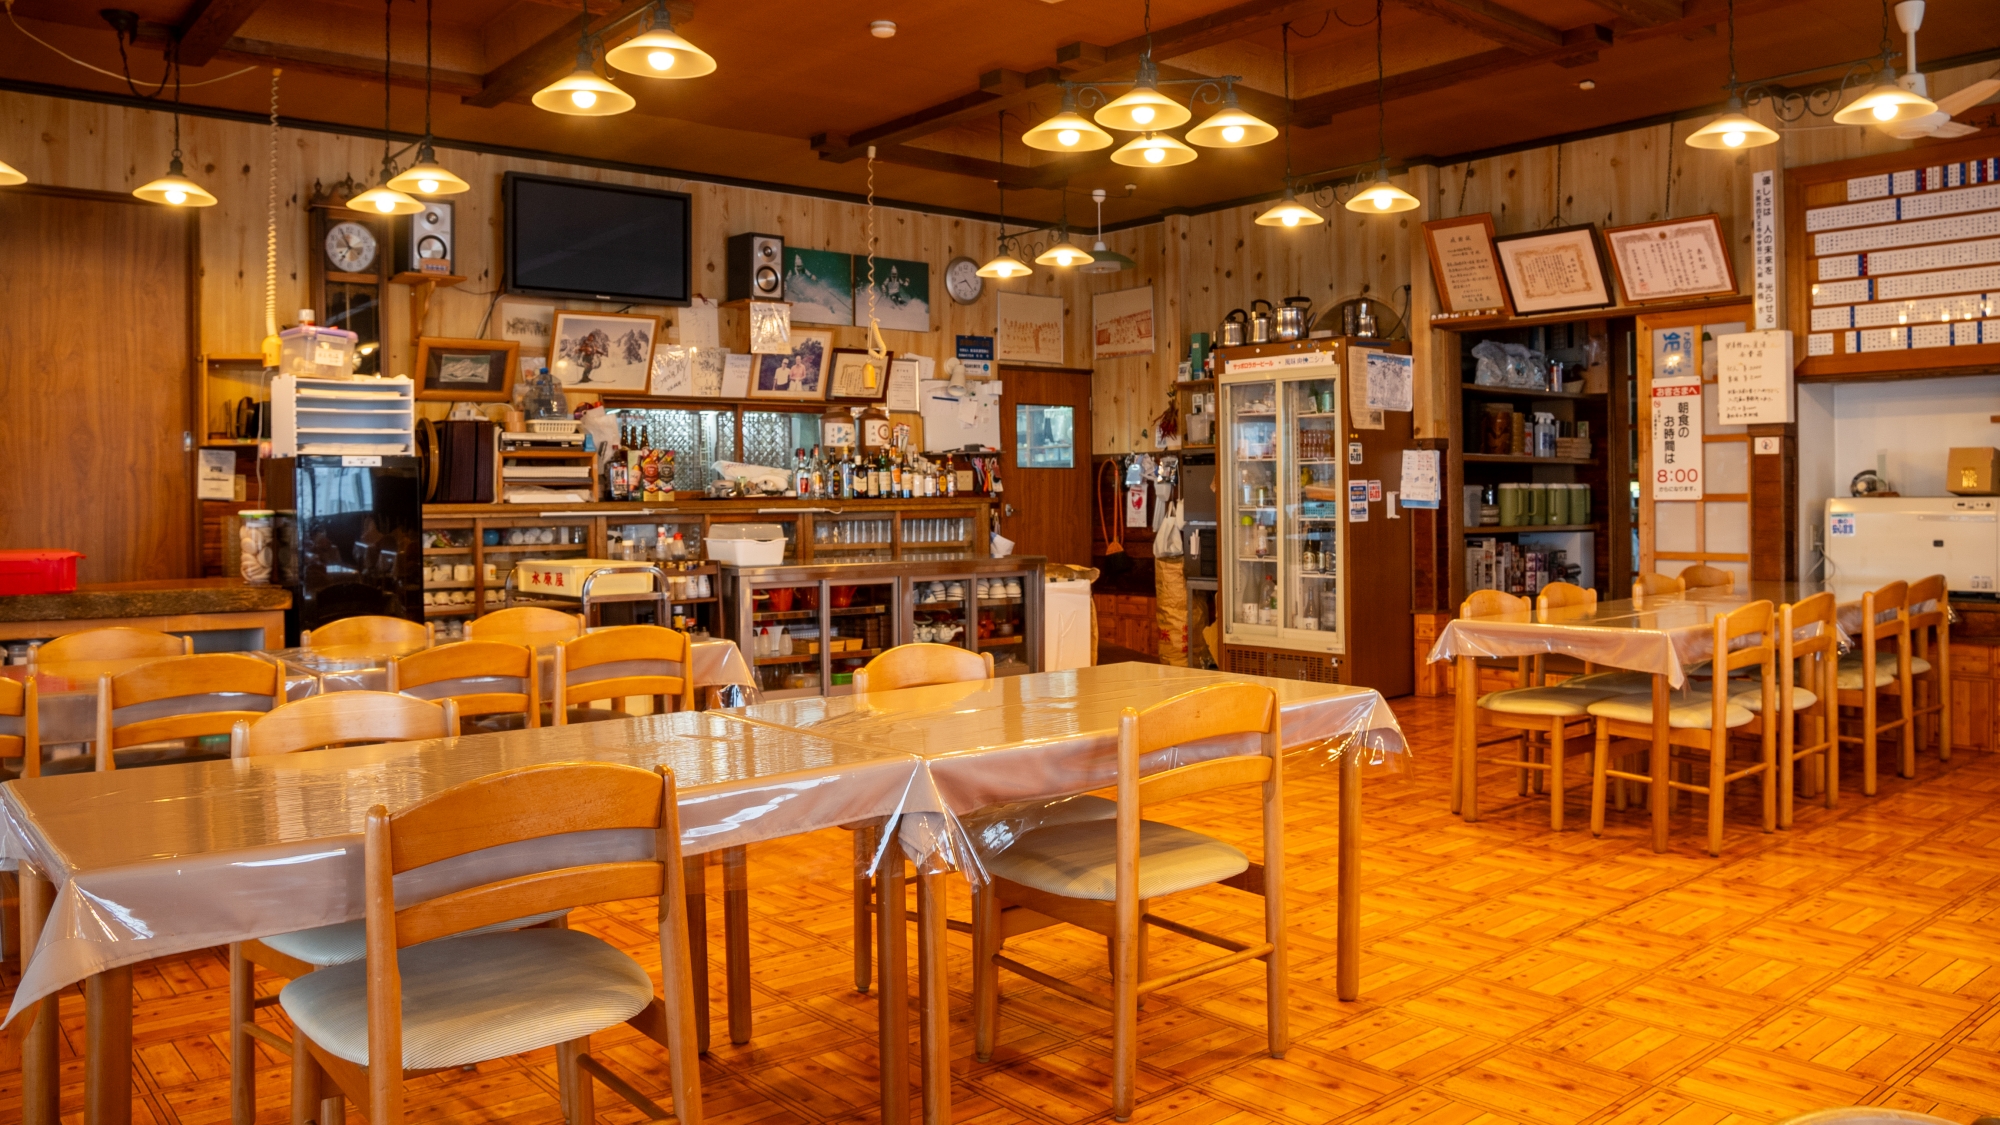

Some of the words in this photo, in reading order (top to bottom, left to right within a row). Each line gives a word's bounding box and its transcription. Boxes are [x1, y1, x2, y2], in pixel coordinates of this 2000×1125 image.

[1762, 176, 1772, 216] 優しさは
[1763, 224, 1773, 275] 人の未来を
[1764, 284, 1774, 324] 光らせる
[1233, 360, 1274, 370] サッポロラガービール
[1655, 387, 1698, 396] お客さまへ
[1677, 401, 1690, 439] 朝食の
[1663, 415, 1676, 465] お時間は
[1657, 468, 1698, 484] 8:00
[1658, 485, 1697, 493] からになります。
[531, 571, 564, 587] 水原屋
